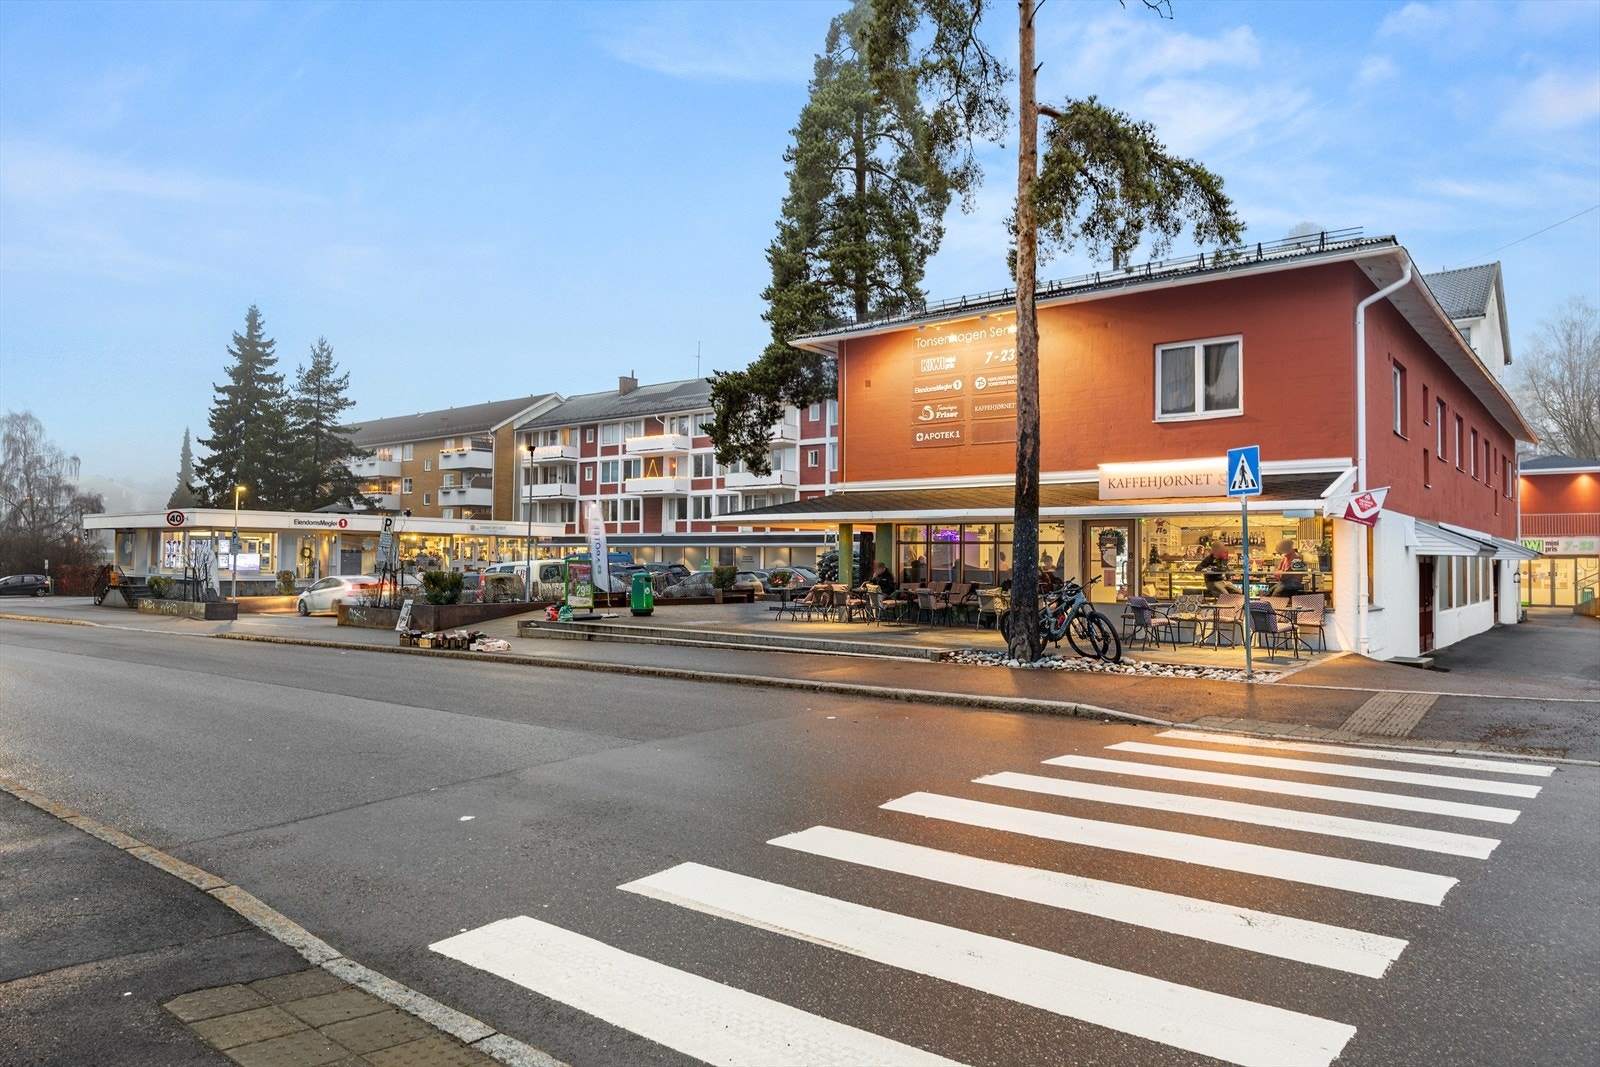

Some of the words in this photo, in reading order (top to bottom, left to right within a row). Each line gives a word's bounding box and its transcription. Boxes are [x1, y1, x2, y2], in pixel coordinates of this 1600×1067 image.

[915, 330, 986, 348] Tonsenhagen
[920, 357, 945, 372] KIWI
[924, 431, 954, 440] APOTEK
[954, 430, 960, 438] 1
[1107, 473, 1213, 489] KAFFEHJØRNET
[169, 514, 182, 523] 40
[293, 518, 338, 528] EiendomsMegler
[384, 518, 392, 531] P
[232, 531, 238, 543] P
[1520, 540, 1544, 553] IWI
